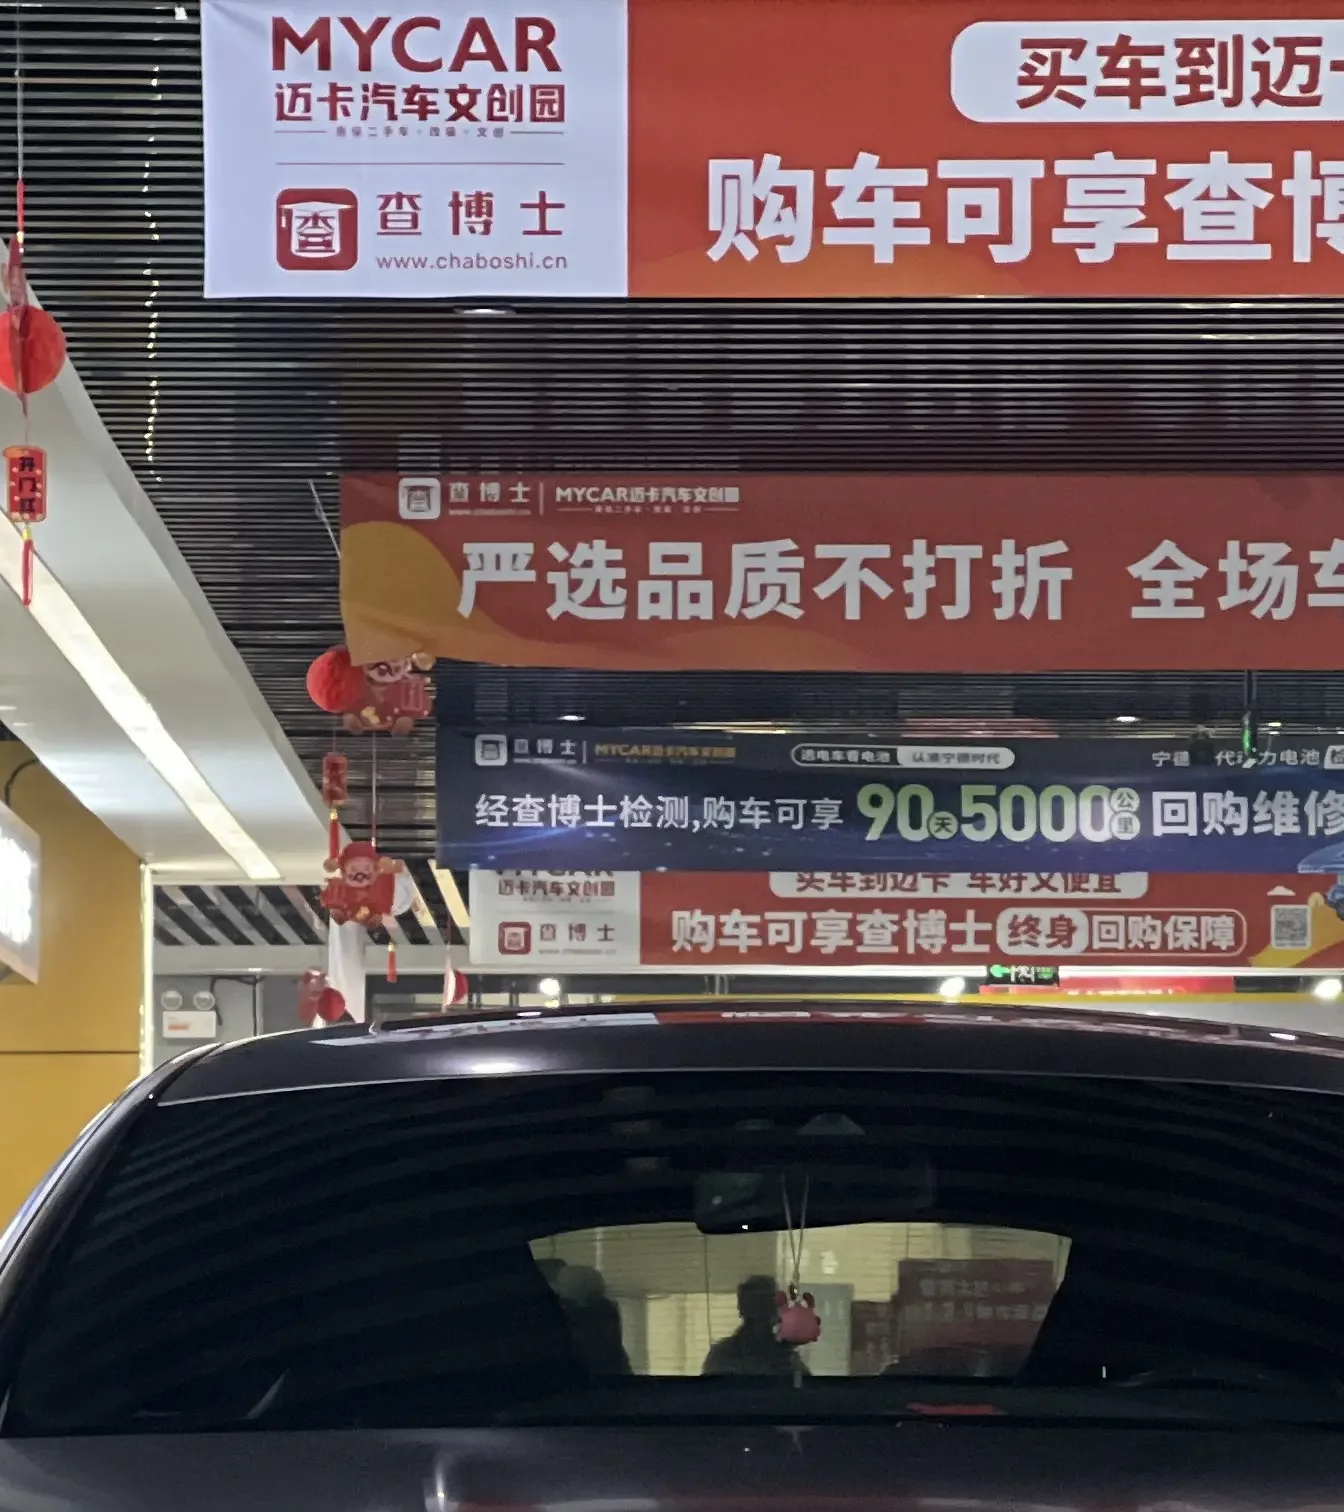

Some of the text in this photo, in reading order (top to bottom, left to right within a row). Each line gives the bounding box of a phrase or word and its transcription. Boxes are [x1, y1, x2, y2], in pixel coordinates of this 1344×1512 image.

[272, 16, 562, 72] MYCAR
[275, 82, 566, 123] 迈卡汽车文创园
[376, 190, 566, 236] 查博士
[376, 252, 568, 270] www.chaboshi.cn
[448, 481, 532, 503] 查博士
[456, 538, 1073, 621] 严选品质不打折
[475, 793, 844, 831] 经查博士检测,购车可享
[539, 923, 616, 942] 查博士
[671, 908, 1236, 954] 购车可享查博士 终身 回购保障
